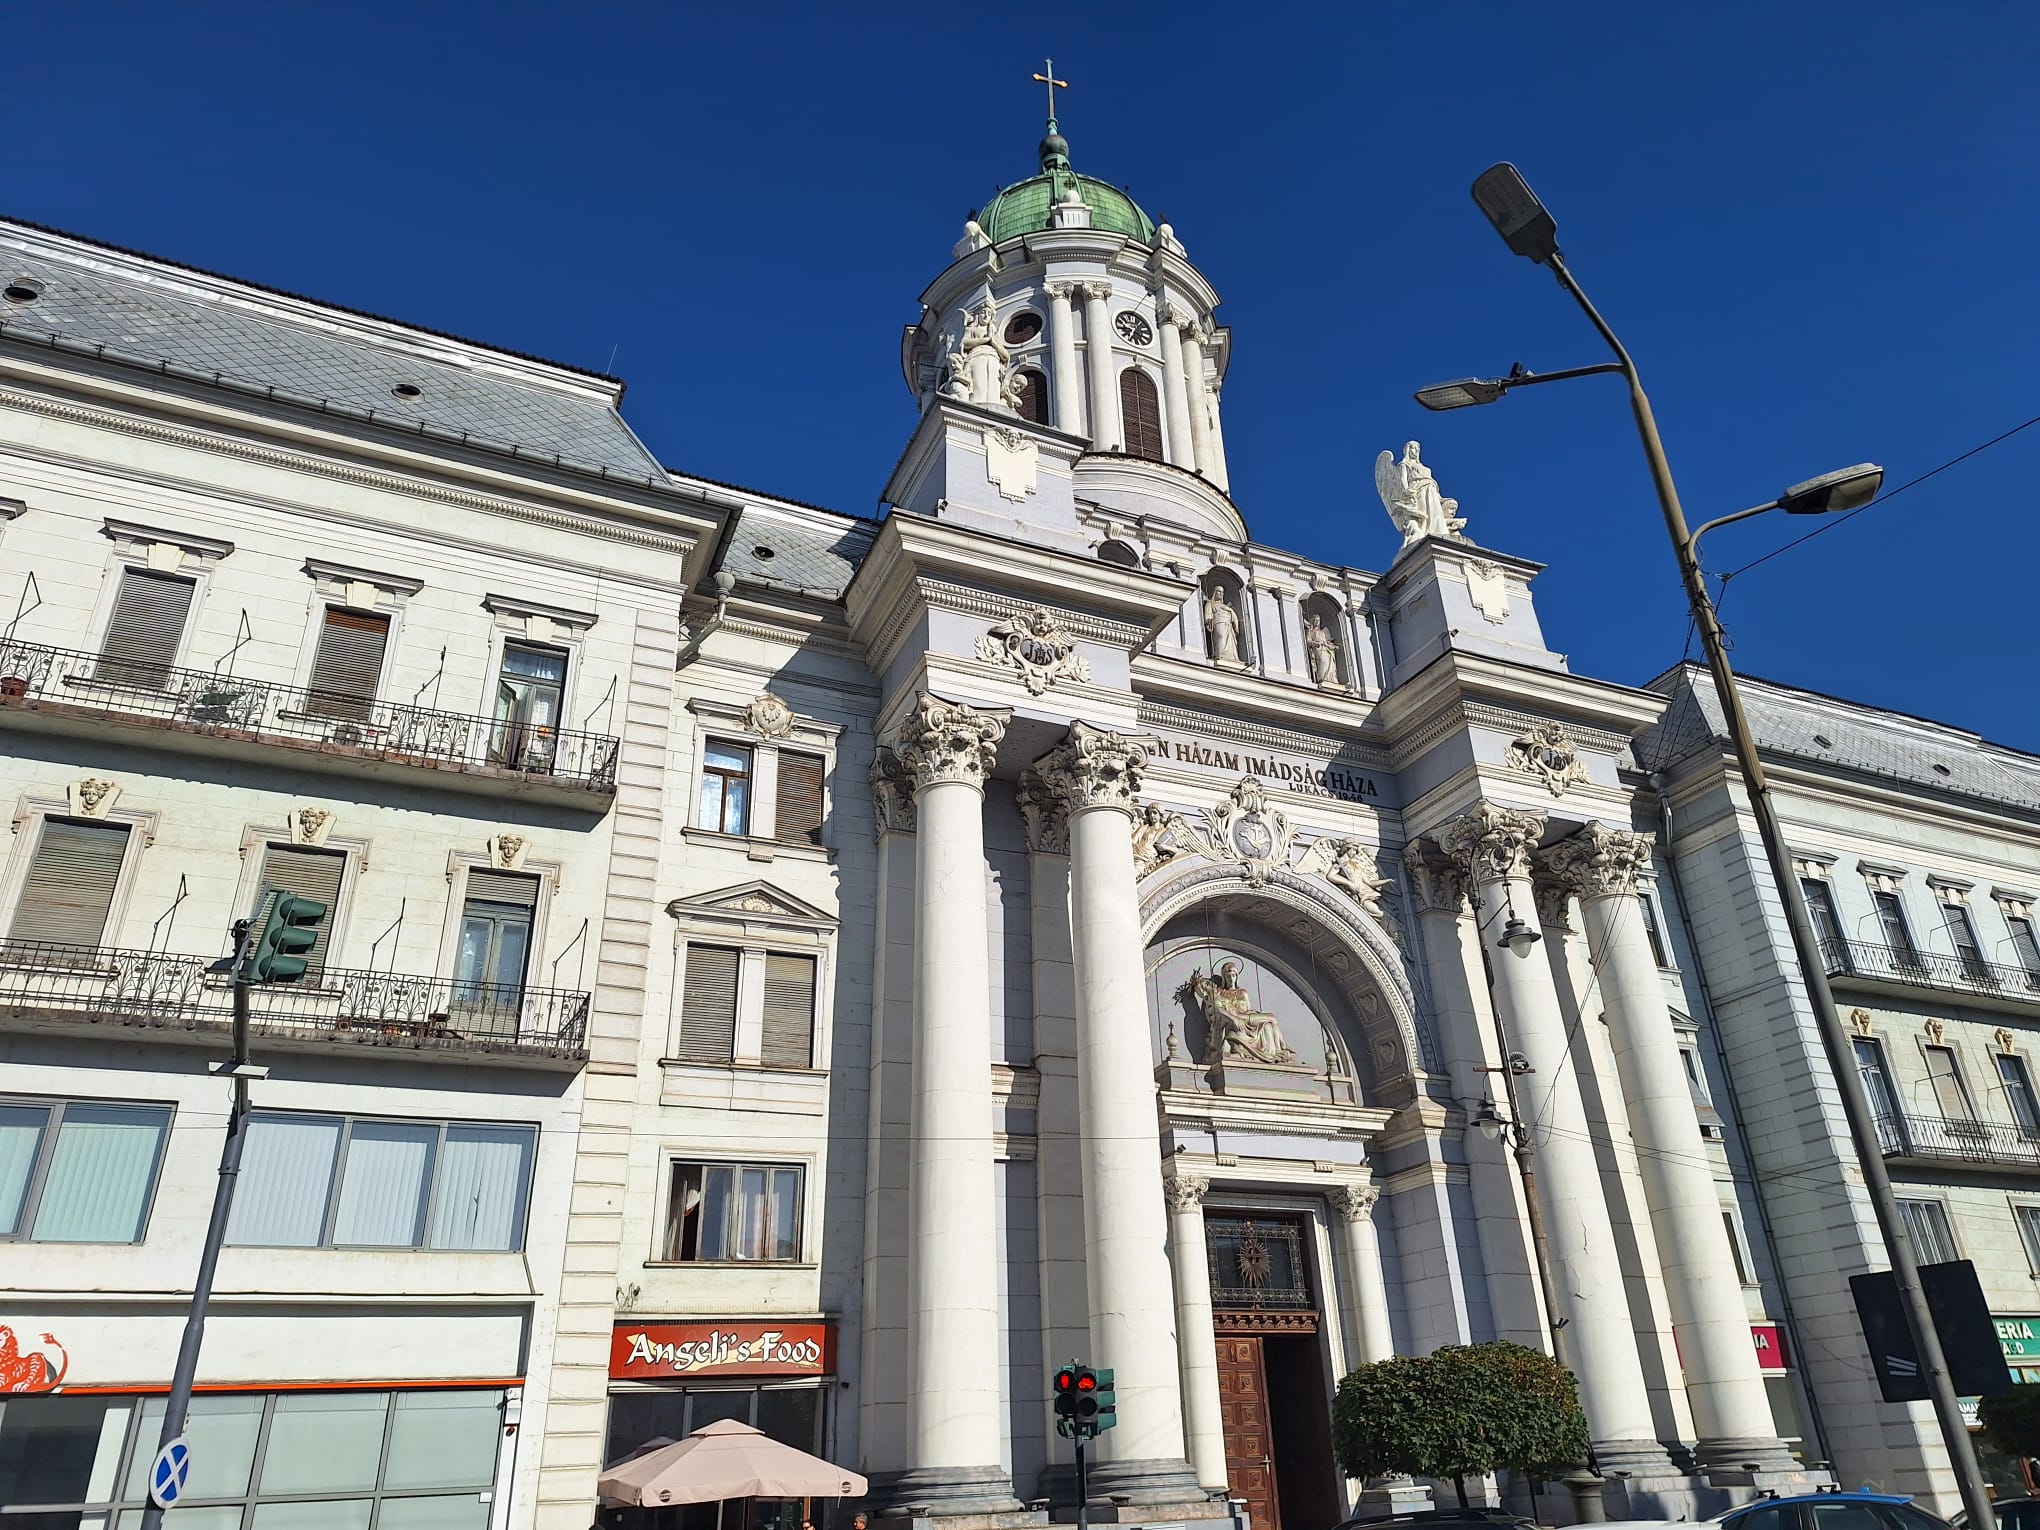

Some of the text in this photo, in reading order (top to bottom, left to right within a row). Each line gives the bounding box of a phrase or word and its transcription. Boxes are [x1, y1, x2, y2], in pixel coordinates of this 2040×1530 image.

[1175, 741, 1240, 771] HÁZAM
[1244, 755, 1328, 789] IMÁDSÁG
[1329, 770, 1378, 797] HÁZA
[624, 1329, 822, 1371] Angeli's Food
